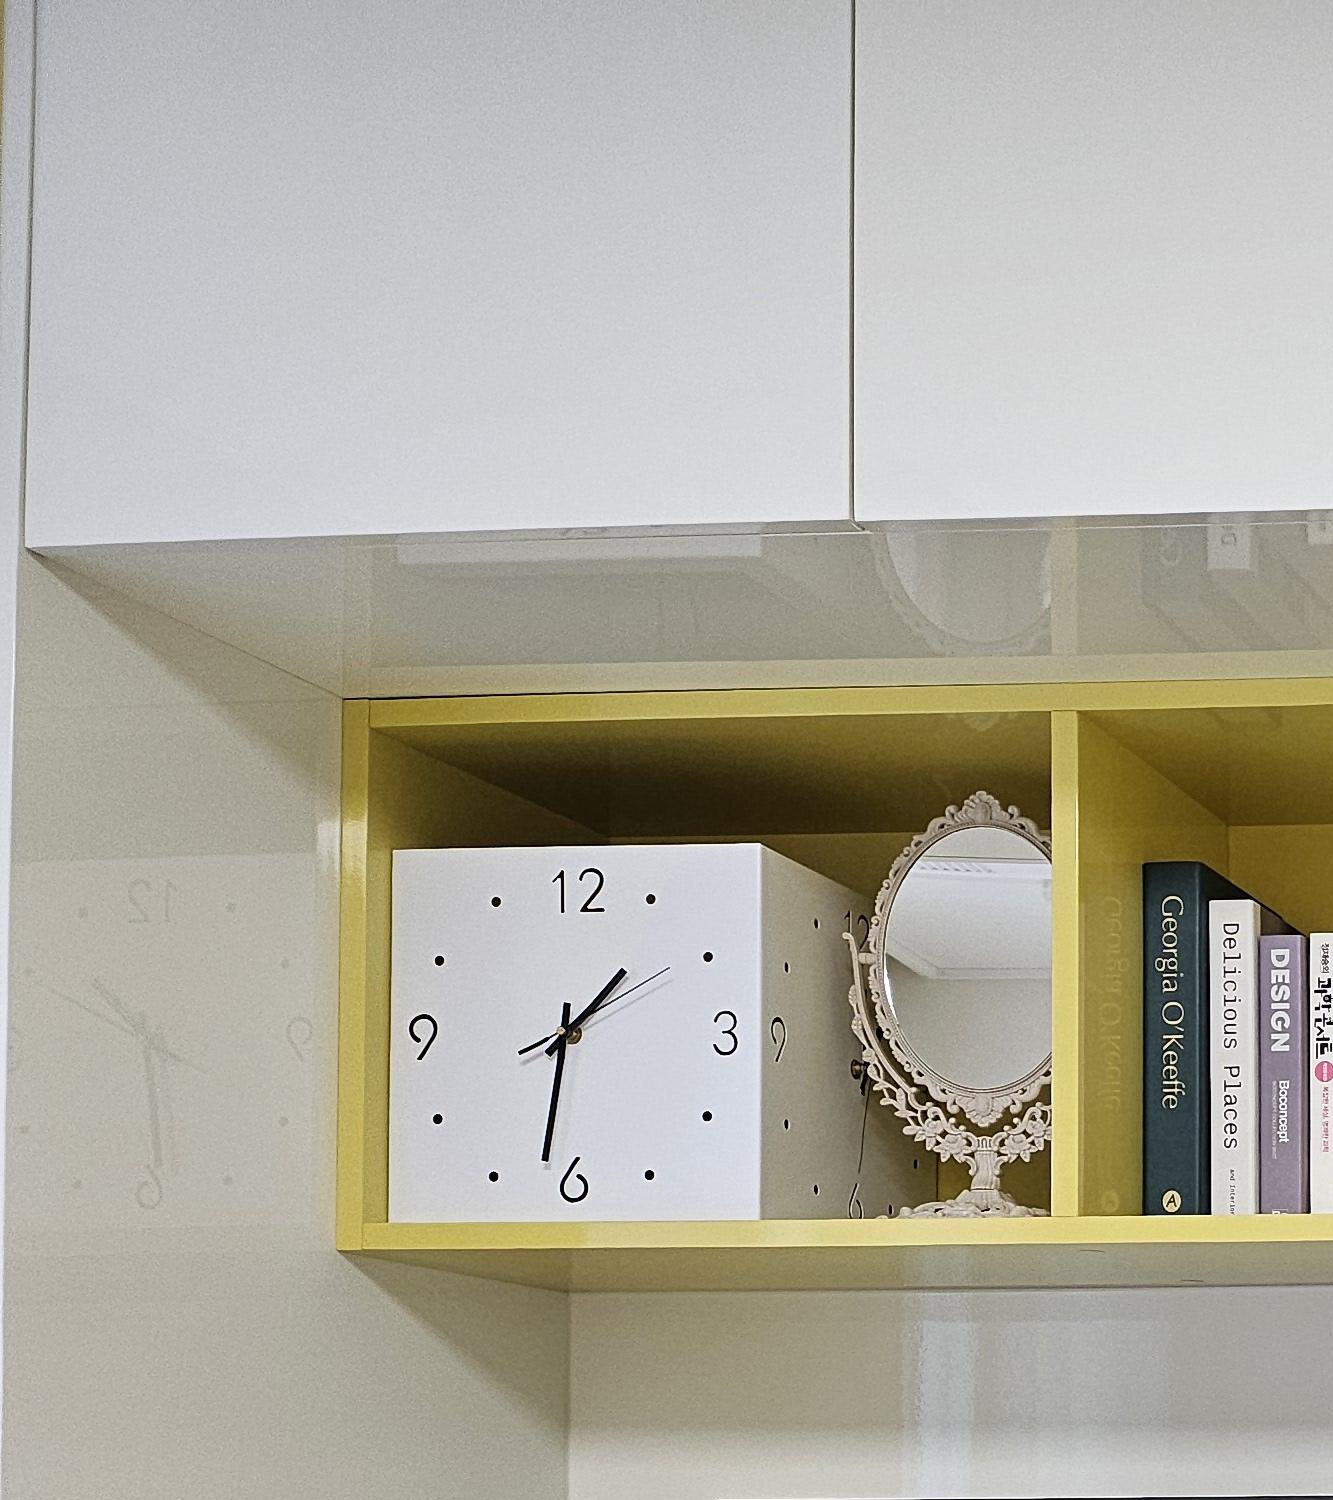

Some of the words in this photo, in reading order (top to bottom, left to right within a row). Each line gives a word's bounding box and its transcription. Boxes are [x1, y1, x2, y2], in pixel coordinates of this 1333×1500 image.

[551, 867, 606, 914] 12
[1155, 895, 1185, 995] Georgia
[1221, 923, 1241, 1050] Delicious
[1270, 948, 1291, 1053] DESIGN
[408, 1013, 438, 1061] 9
[712, 1010, 739, 1056] 3
[770, 1016, 788, 1063] 9
[1161, 1000, 1186, 1110] O'Keeffe
[1222, 1065, 1241, 1150] Places
[1277, 1080, 1290, 1143] Boconcept
[558, 1156, 590, 1203] 6
[847, 1183, 864, 1219] 6
